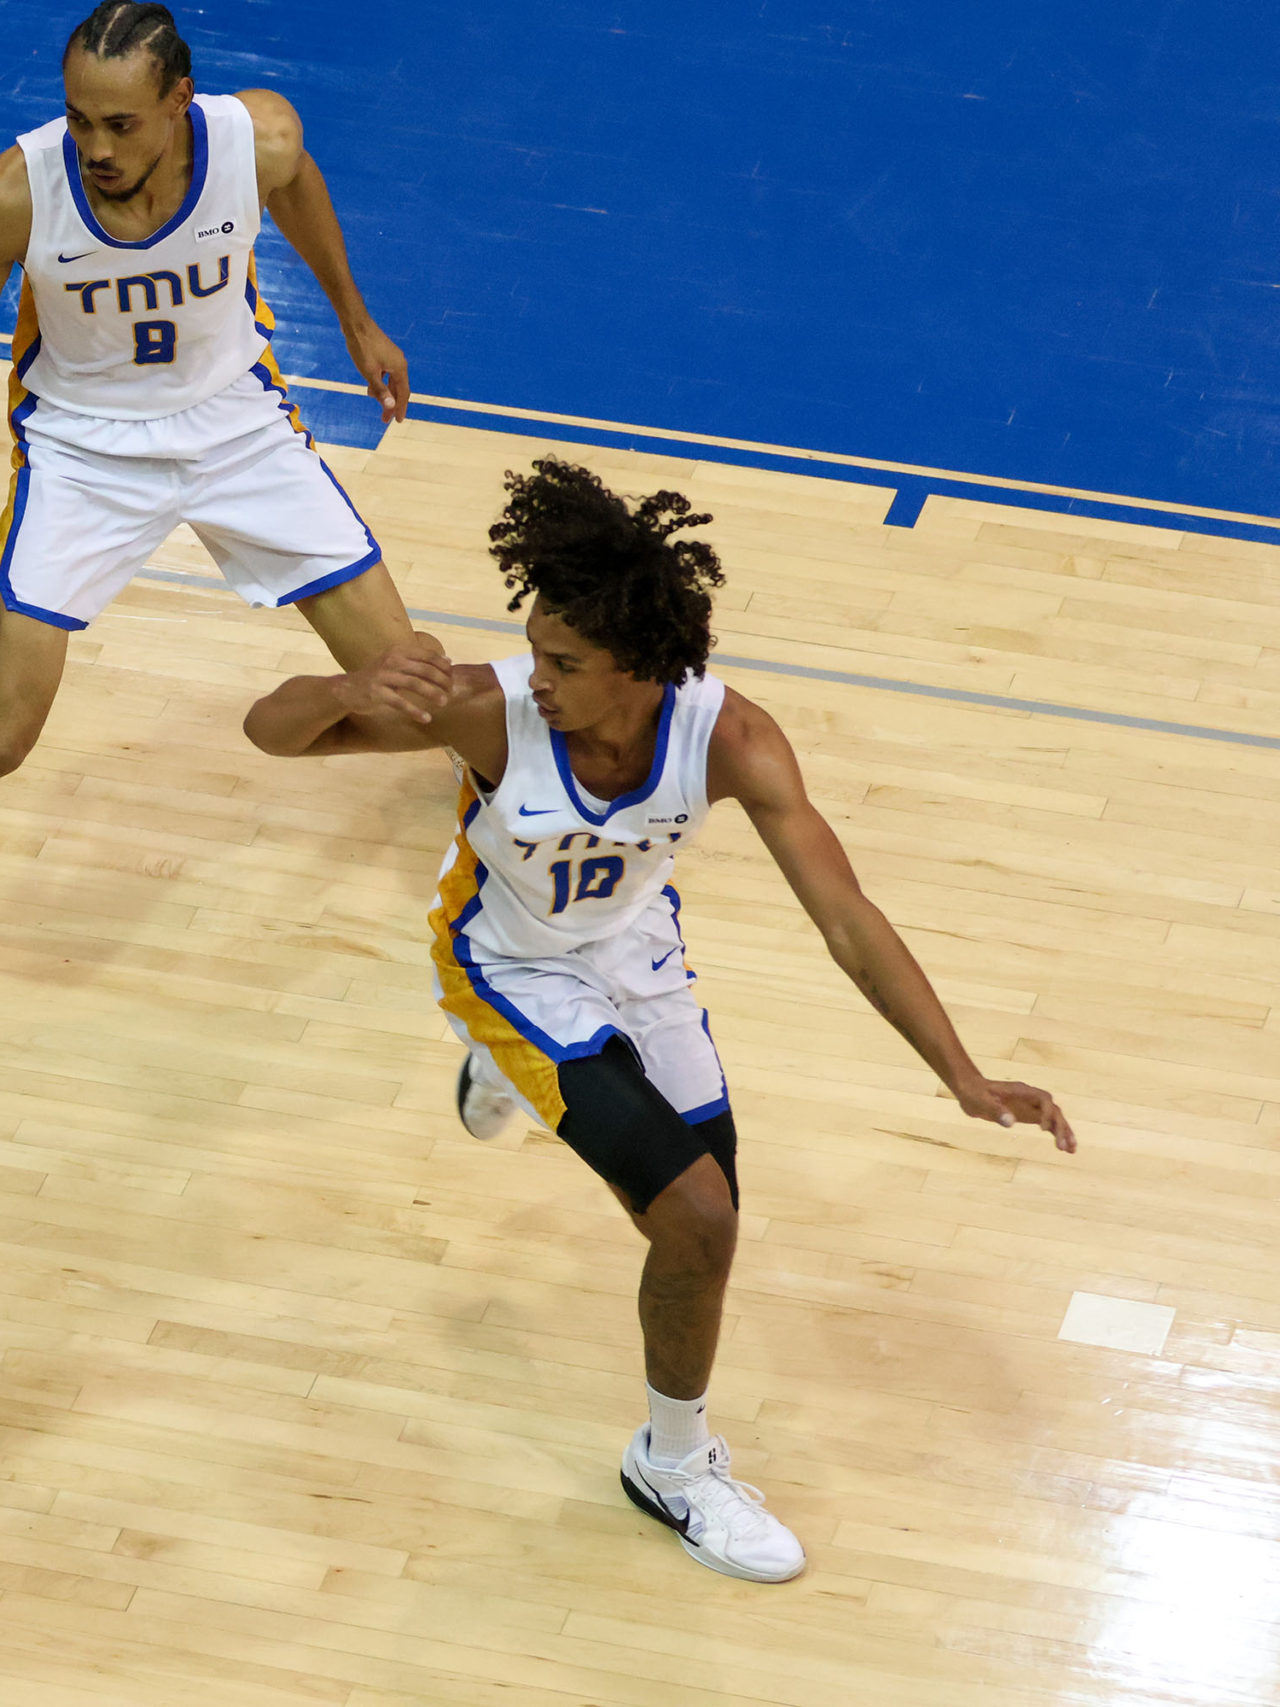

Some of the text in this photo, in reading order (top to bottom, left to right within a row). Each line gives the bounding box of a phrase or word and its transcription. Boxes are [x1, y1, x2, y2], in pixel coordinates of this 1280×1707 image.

[197, 227, 219, 239] BMO
[64, 254, 231, 314] TMU
[547, 854, 626, 917] 10
